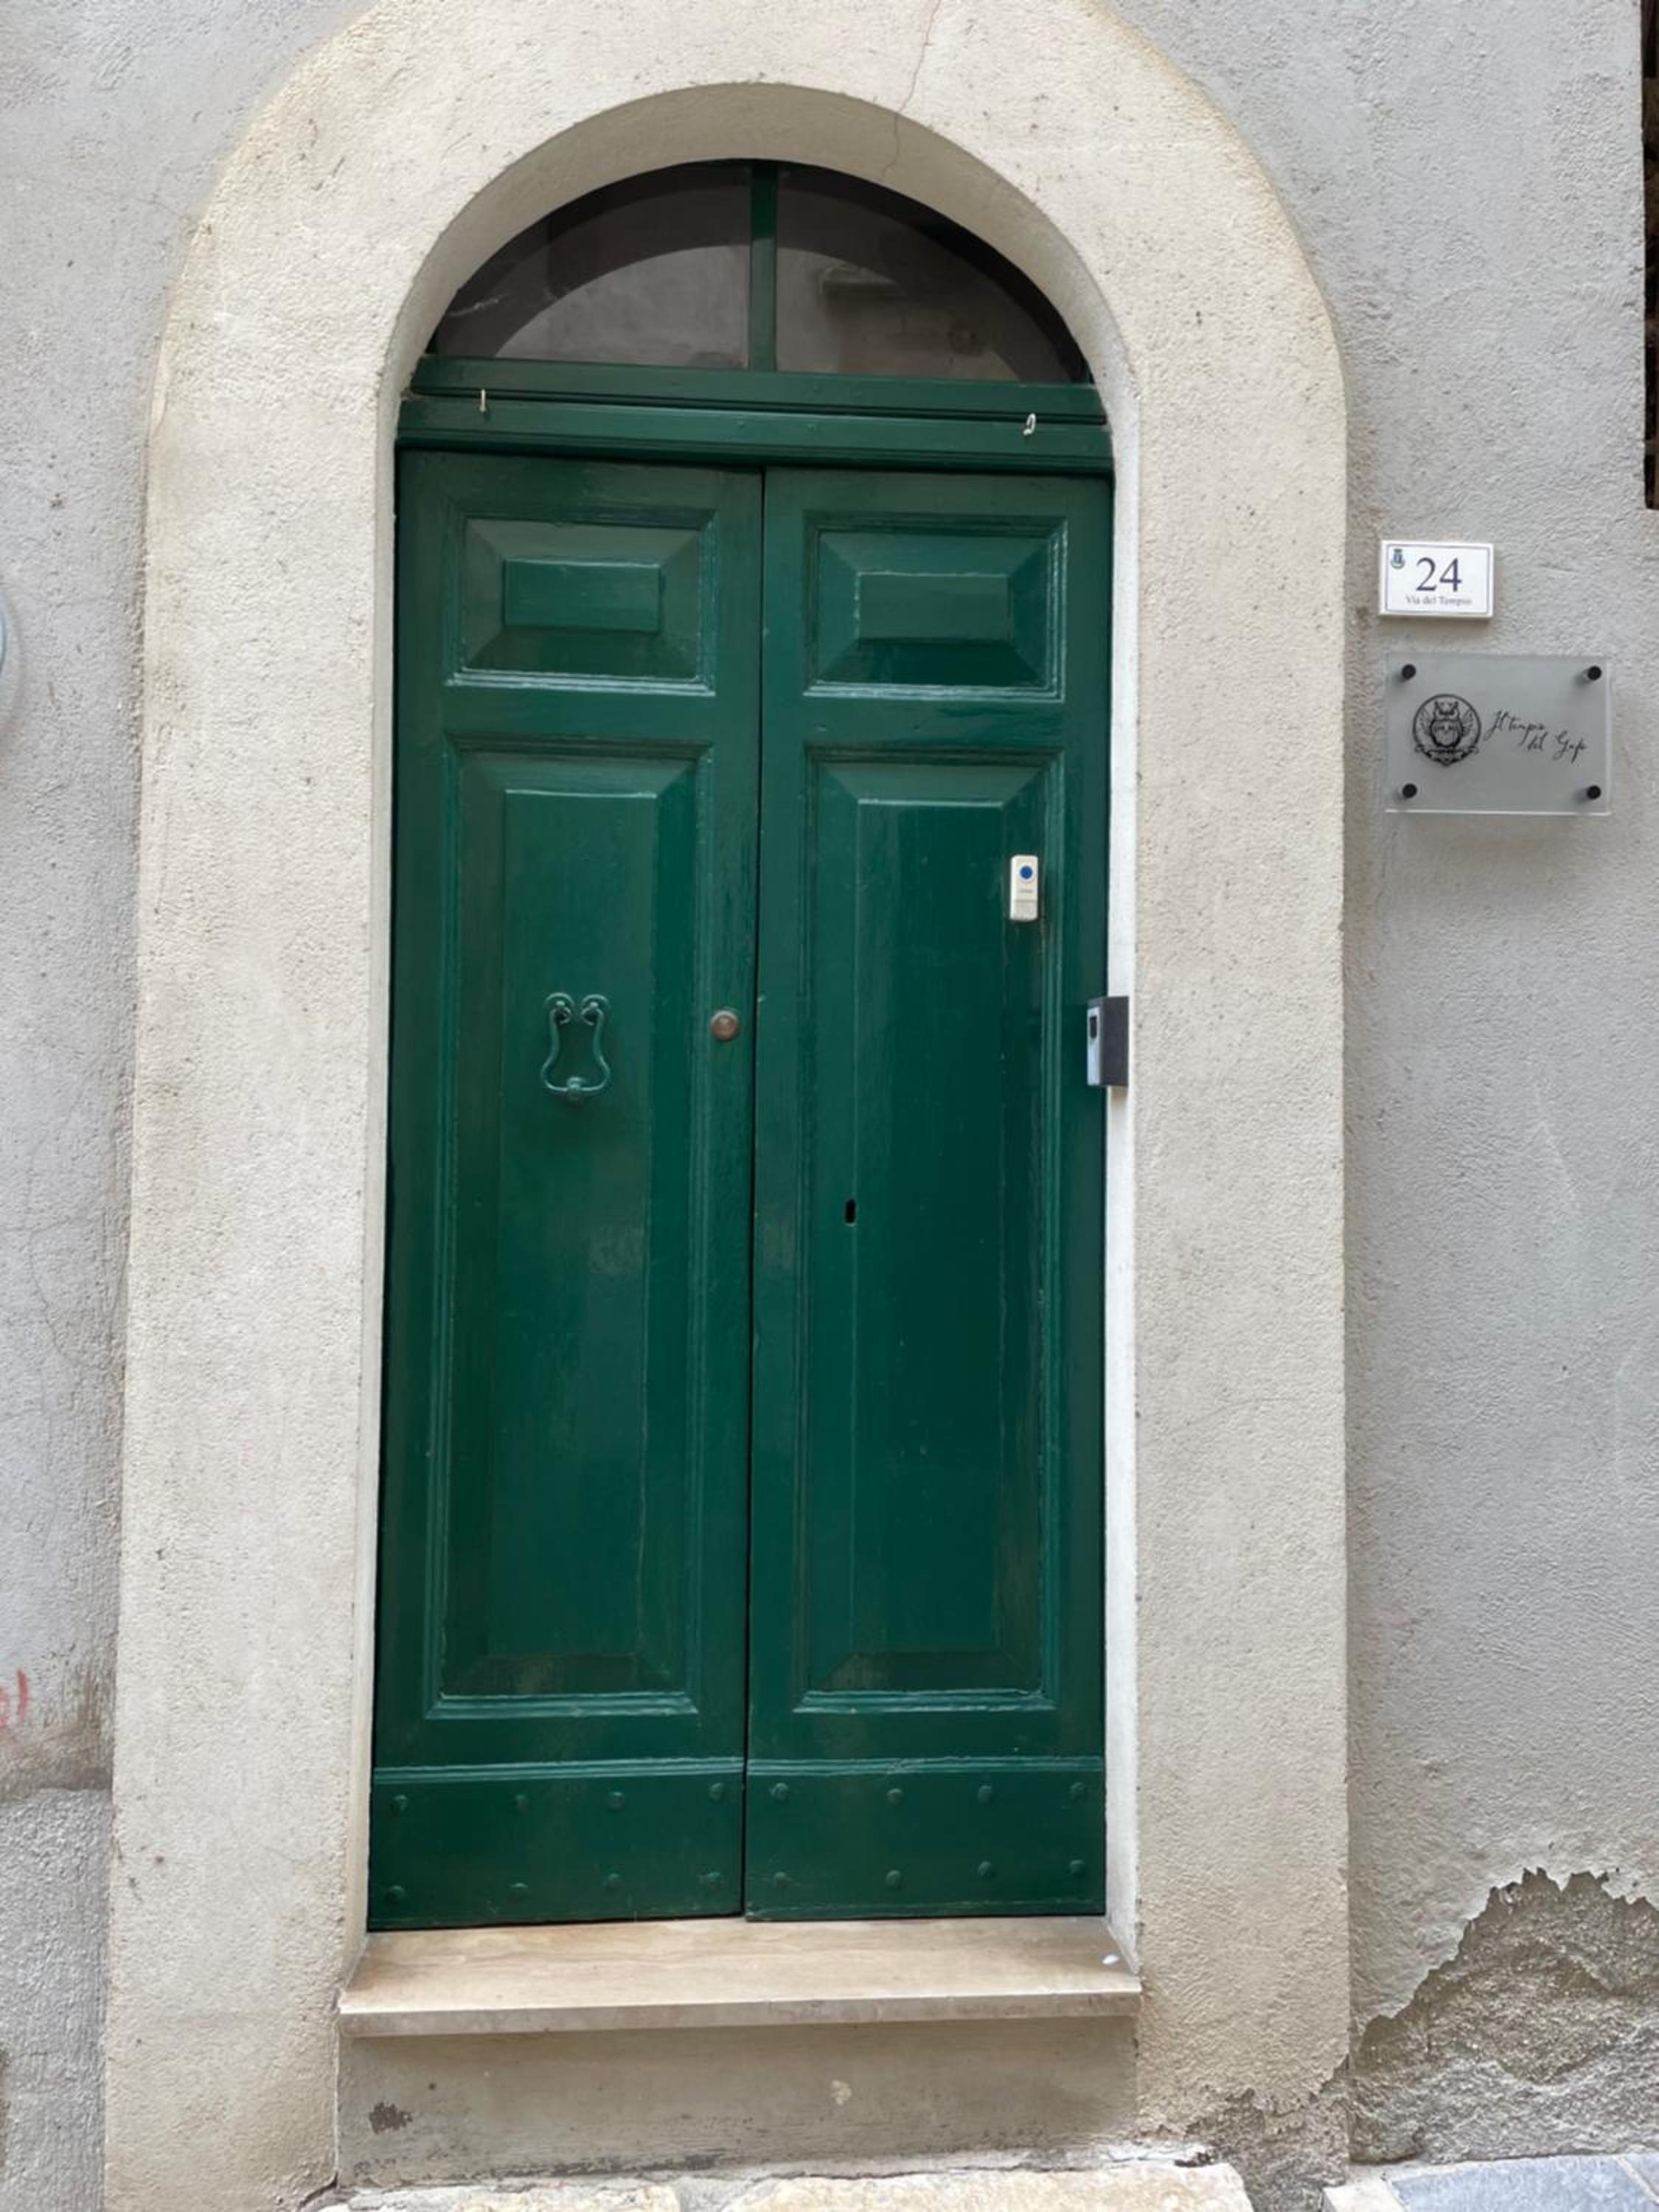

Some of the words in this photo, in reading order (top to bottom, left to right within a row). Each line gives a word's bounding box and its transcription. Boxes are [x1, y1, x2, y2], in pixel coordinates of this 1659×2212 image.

[1416, 557, 1462, 592] 24
[1405, 594, 1420, 605] Via
[1423, 595, 1436, 605] del
